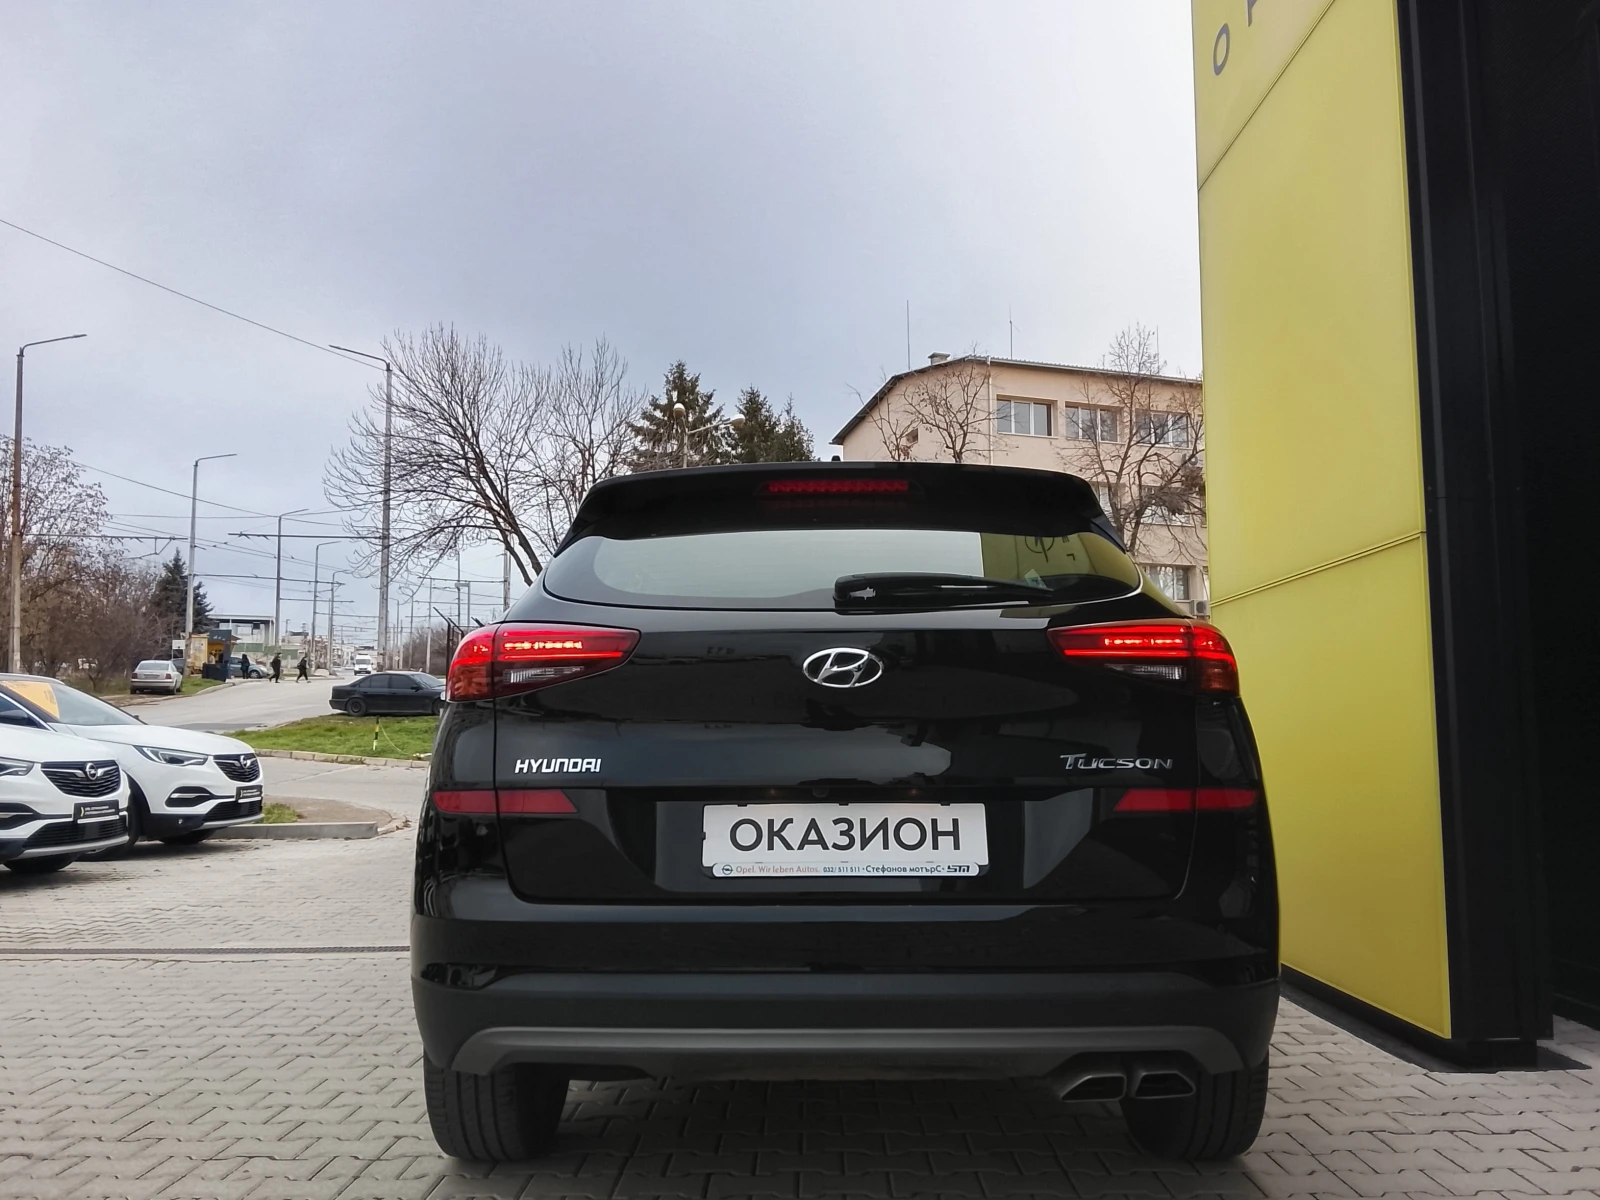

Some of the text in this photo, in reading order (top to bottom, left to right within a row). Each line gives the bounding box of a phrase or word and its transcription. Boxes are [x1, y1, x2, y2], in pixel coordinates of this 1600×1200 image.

[515, 758, 602, 774] HYUNDAI
[1060, 753, 1173, 770] TUCSON
[729, 817, 961, 852] ОКАЗИОН
[758, 865, 772, 874] Wir
[772, 865, 794, 874] leben
